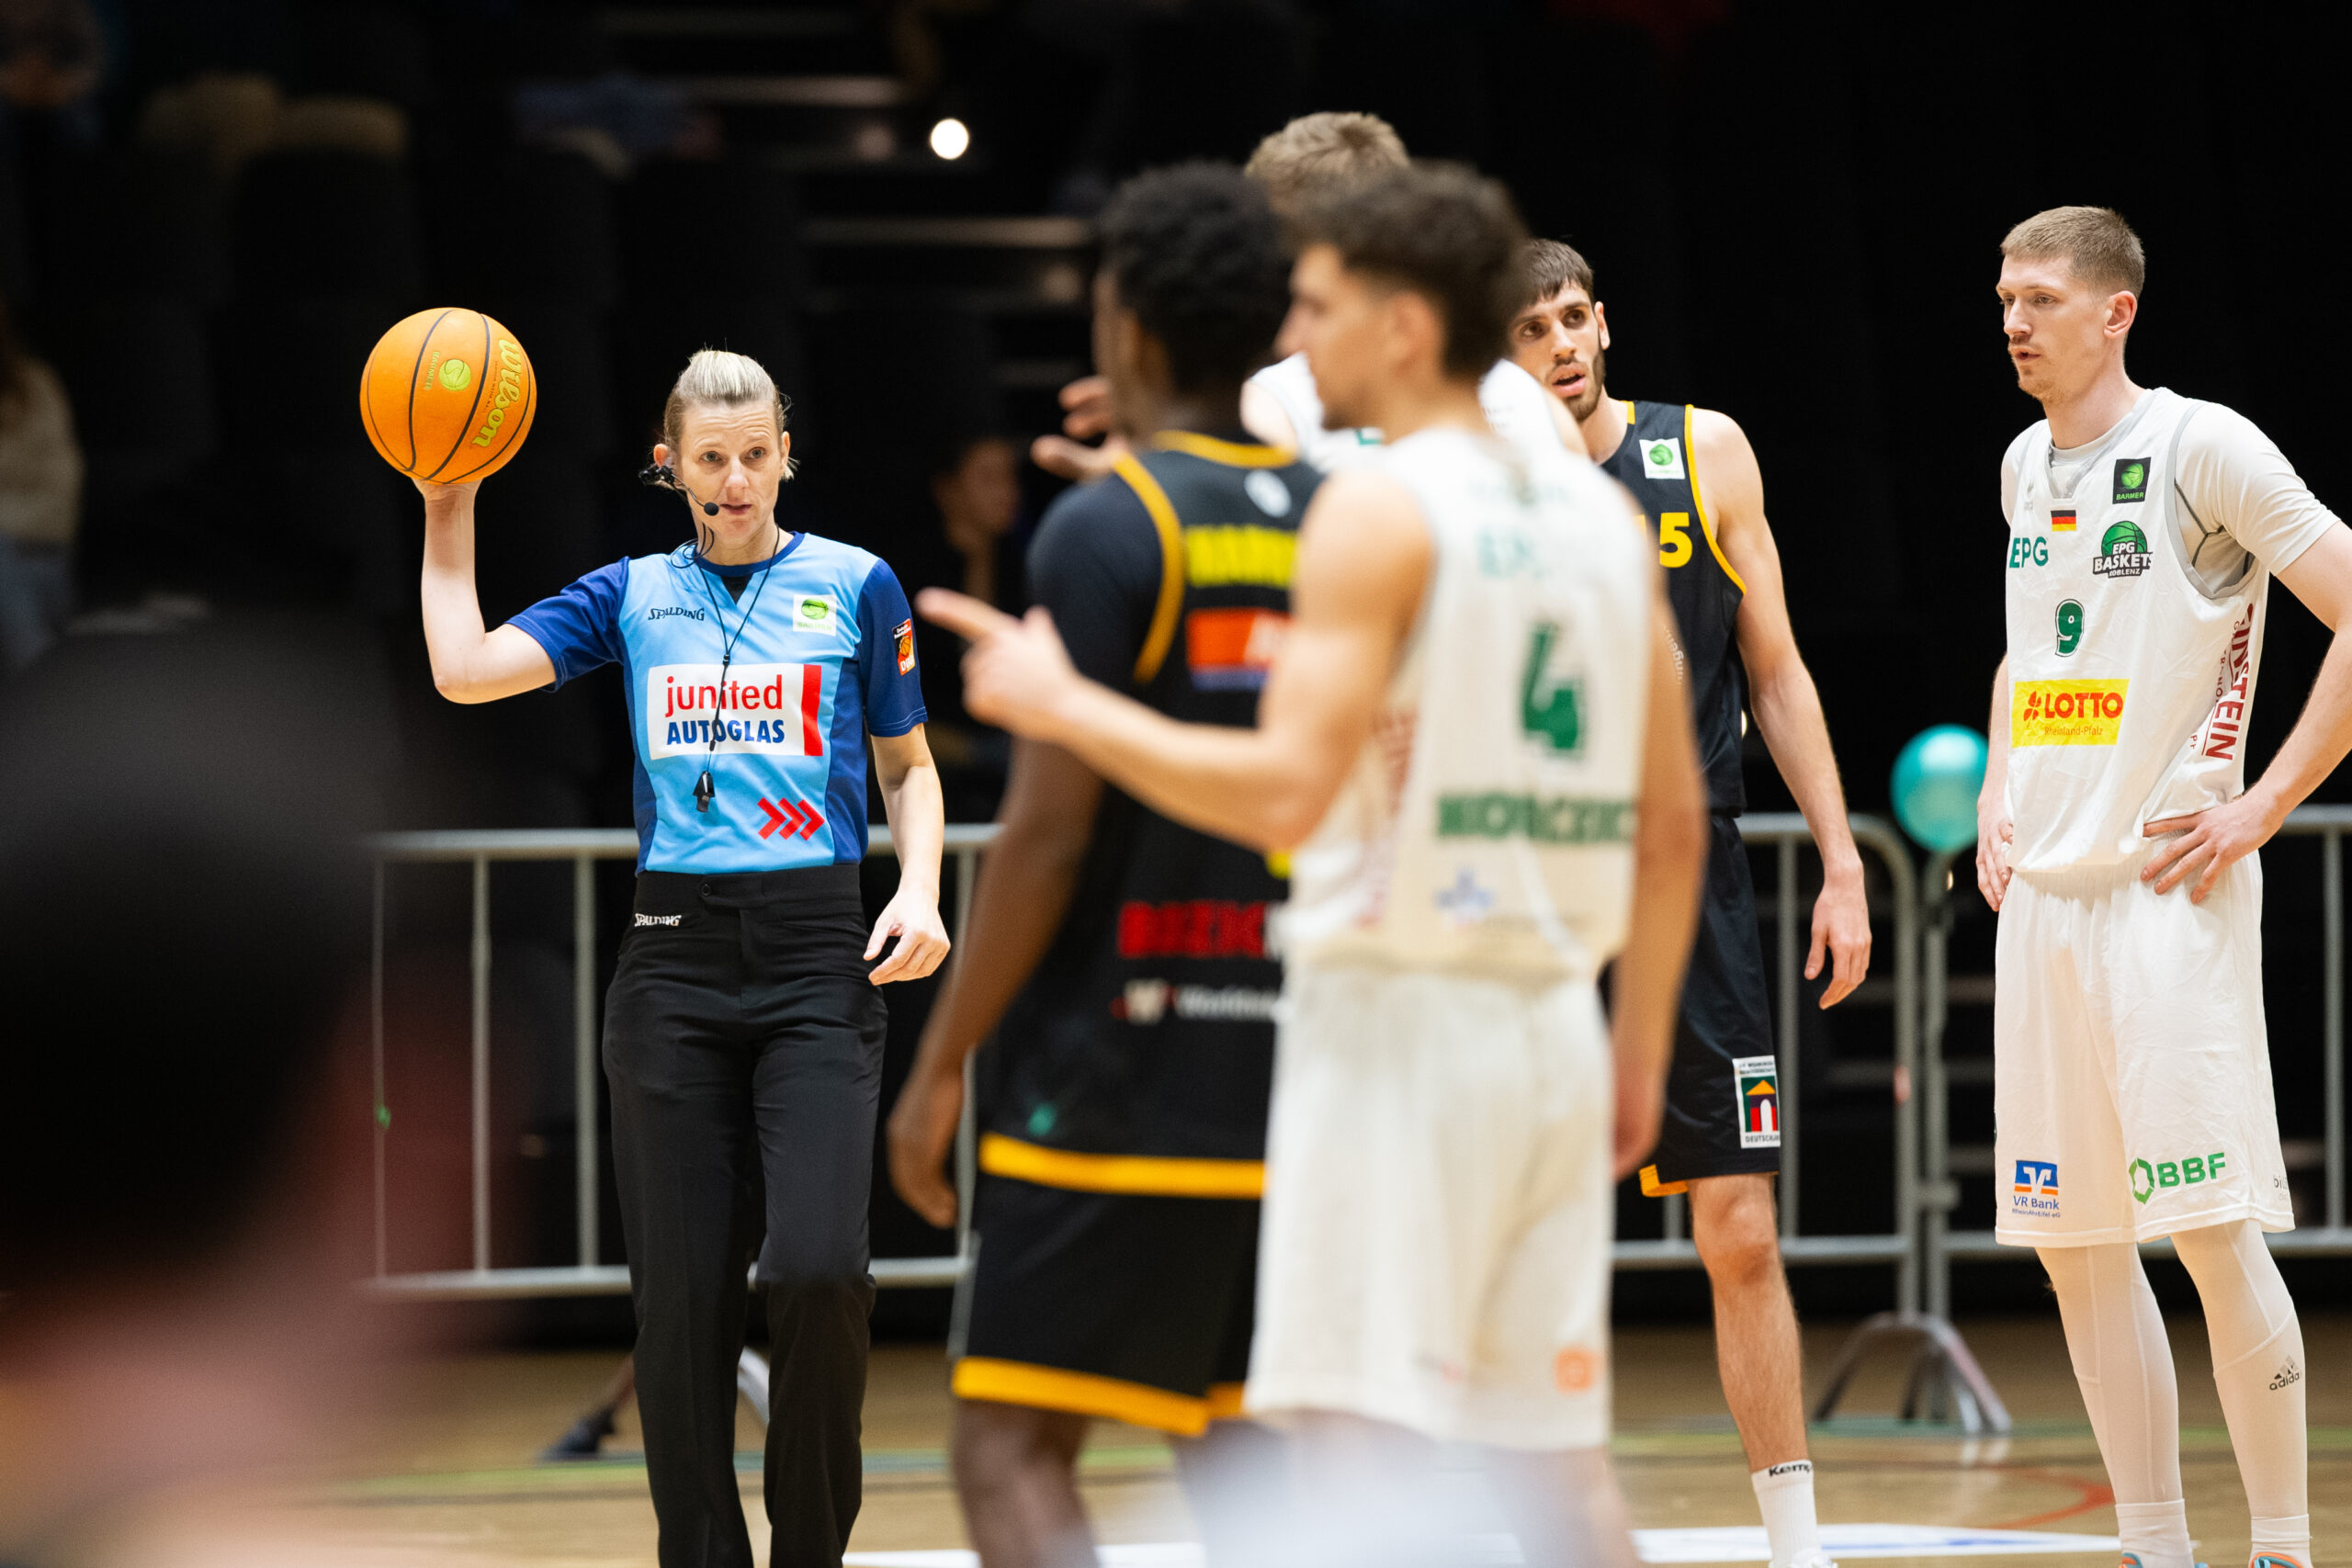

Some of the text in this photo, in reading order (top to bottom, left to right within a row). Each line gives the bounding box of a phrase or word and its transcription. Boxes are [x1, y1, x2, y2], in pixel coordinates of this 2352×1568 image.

[471, 339, 522, 447] Wilson
[2116, 491, 2144, 501] BARMER
[2009, 536, 2049, 569] EPG
[2112, 541, 2135, 555] EPG
[648, 606, 705, 621] SPALDING
[2055, 599, 2085, 657] 9
[665, 674, 783, 718] junited
[1521, 622, 1586, 761] 4
[2044, 692, 2123, 718] LOTTO
[667, 719, 785, 746] AUTOGLAS
[2044, 726, 2103, 736] Rheinland-Pfalz
[634, 913, 682, 927] SPALDING
[2156, 1152, 2226, 1189] BBF
[2013, 1195, 2060, 1210] VR Bank
